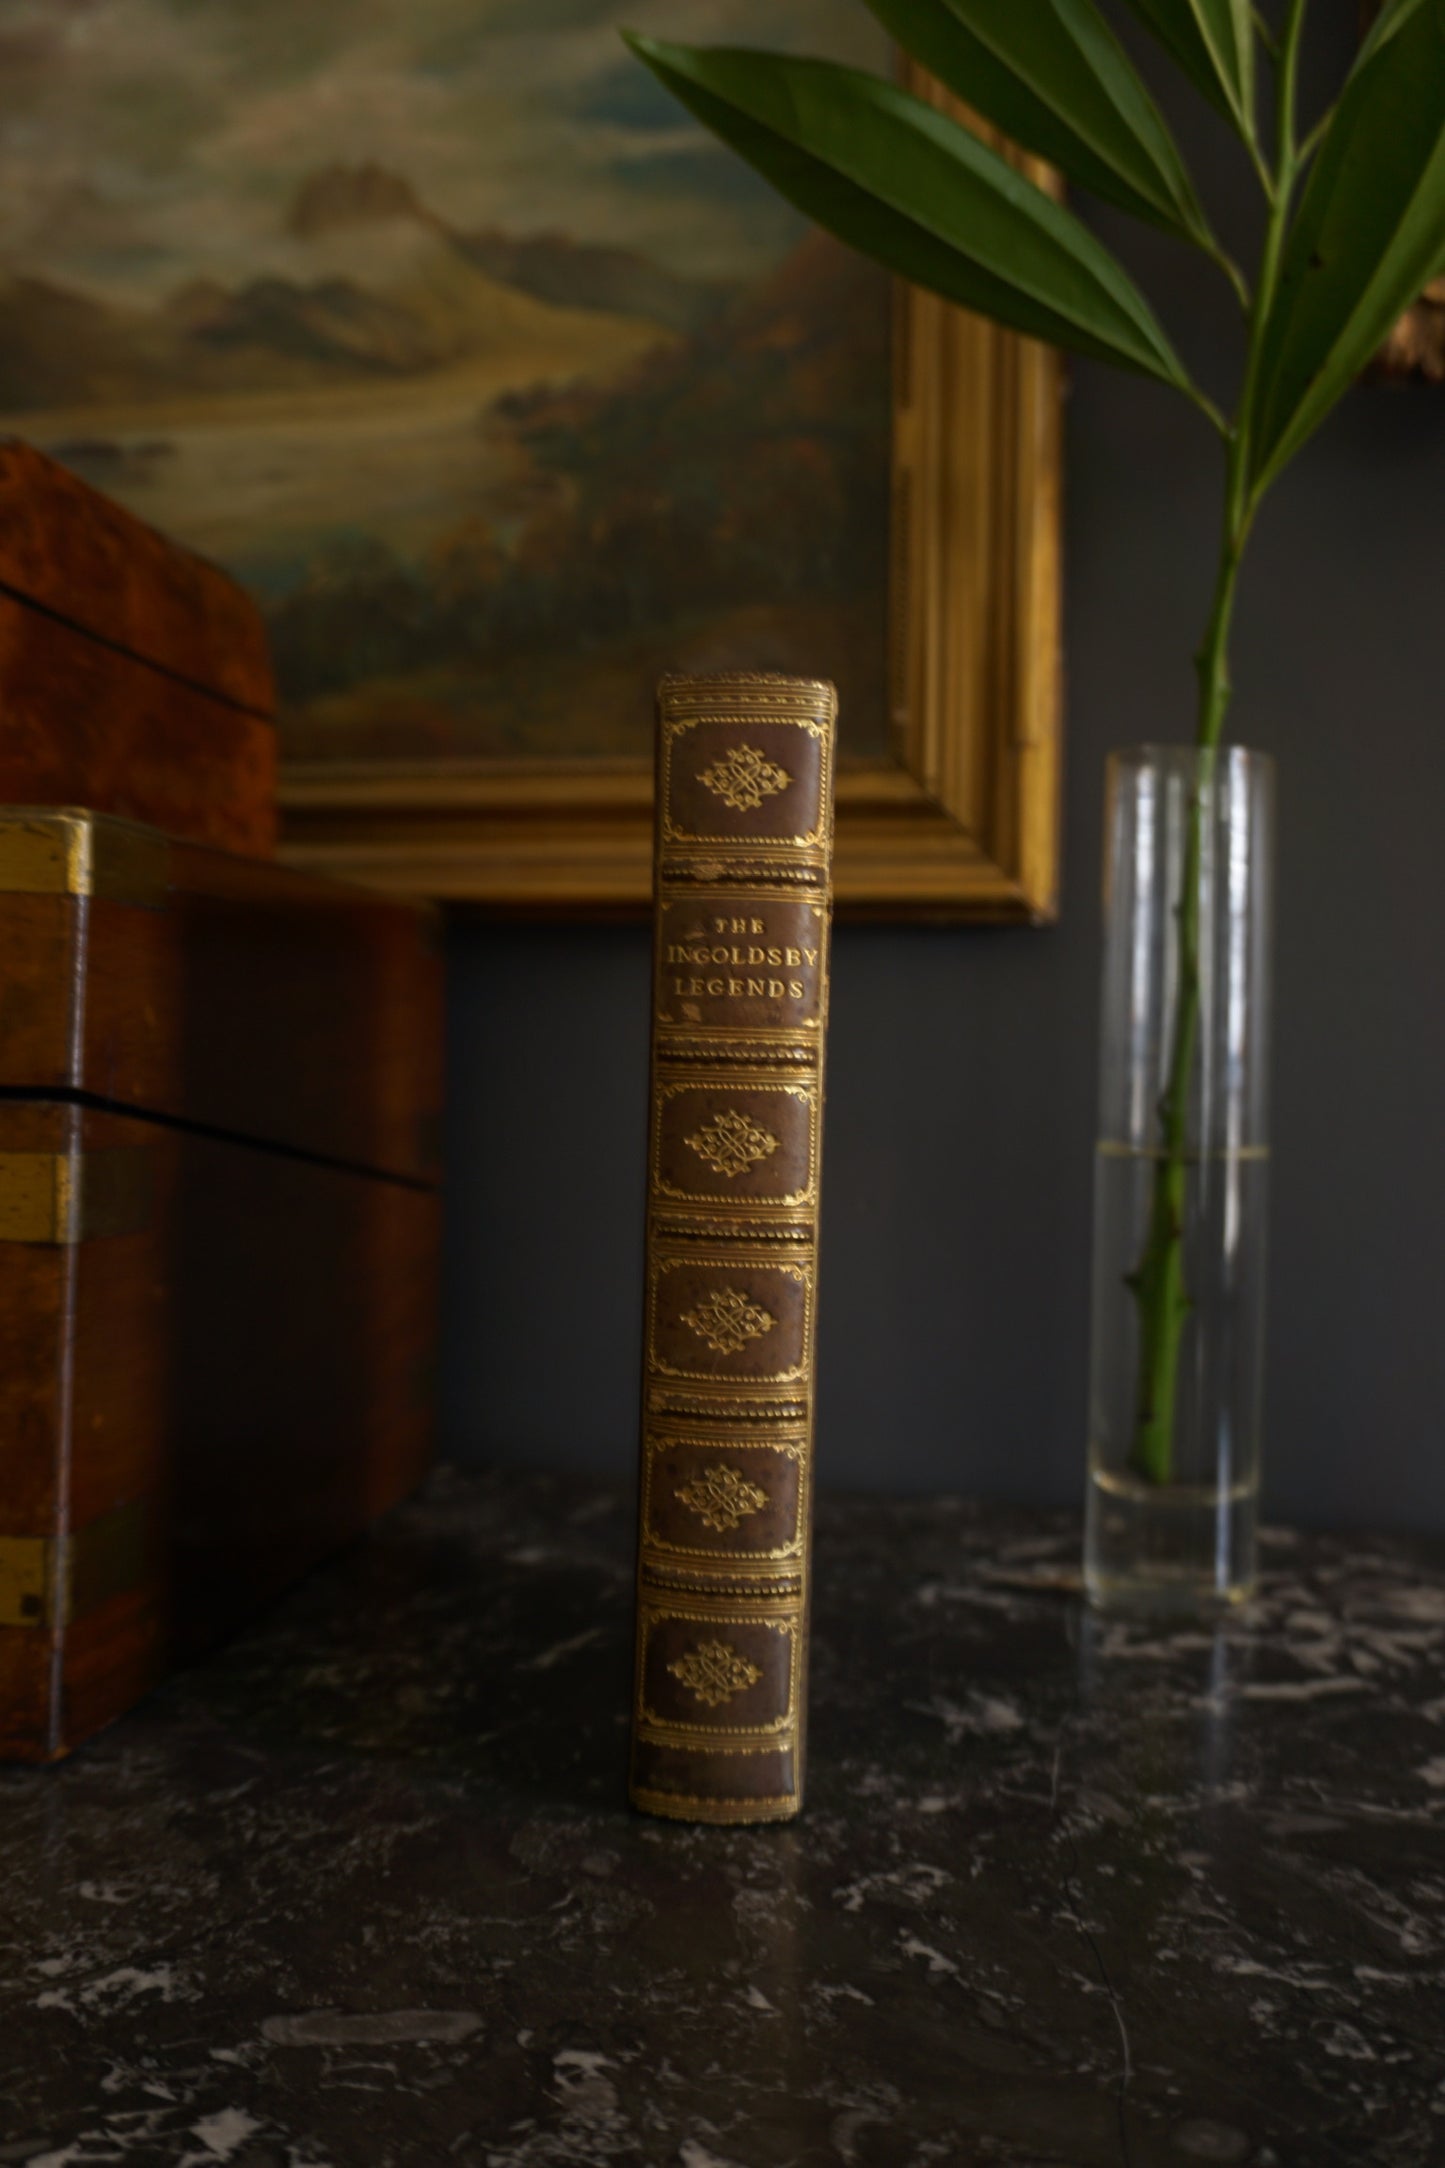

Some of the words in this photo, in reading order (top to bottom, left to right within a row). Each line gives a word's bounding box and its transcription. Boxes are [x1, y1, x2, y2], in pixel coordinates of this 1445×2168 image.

[715, 918, 764, 934] THE
[668, 946, 818, 966] INGOLDSBY
[675, 979, 804, 999] LEGENDS
